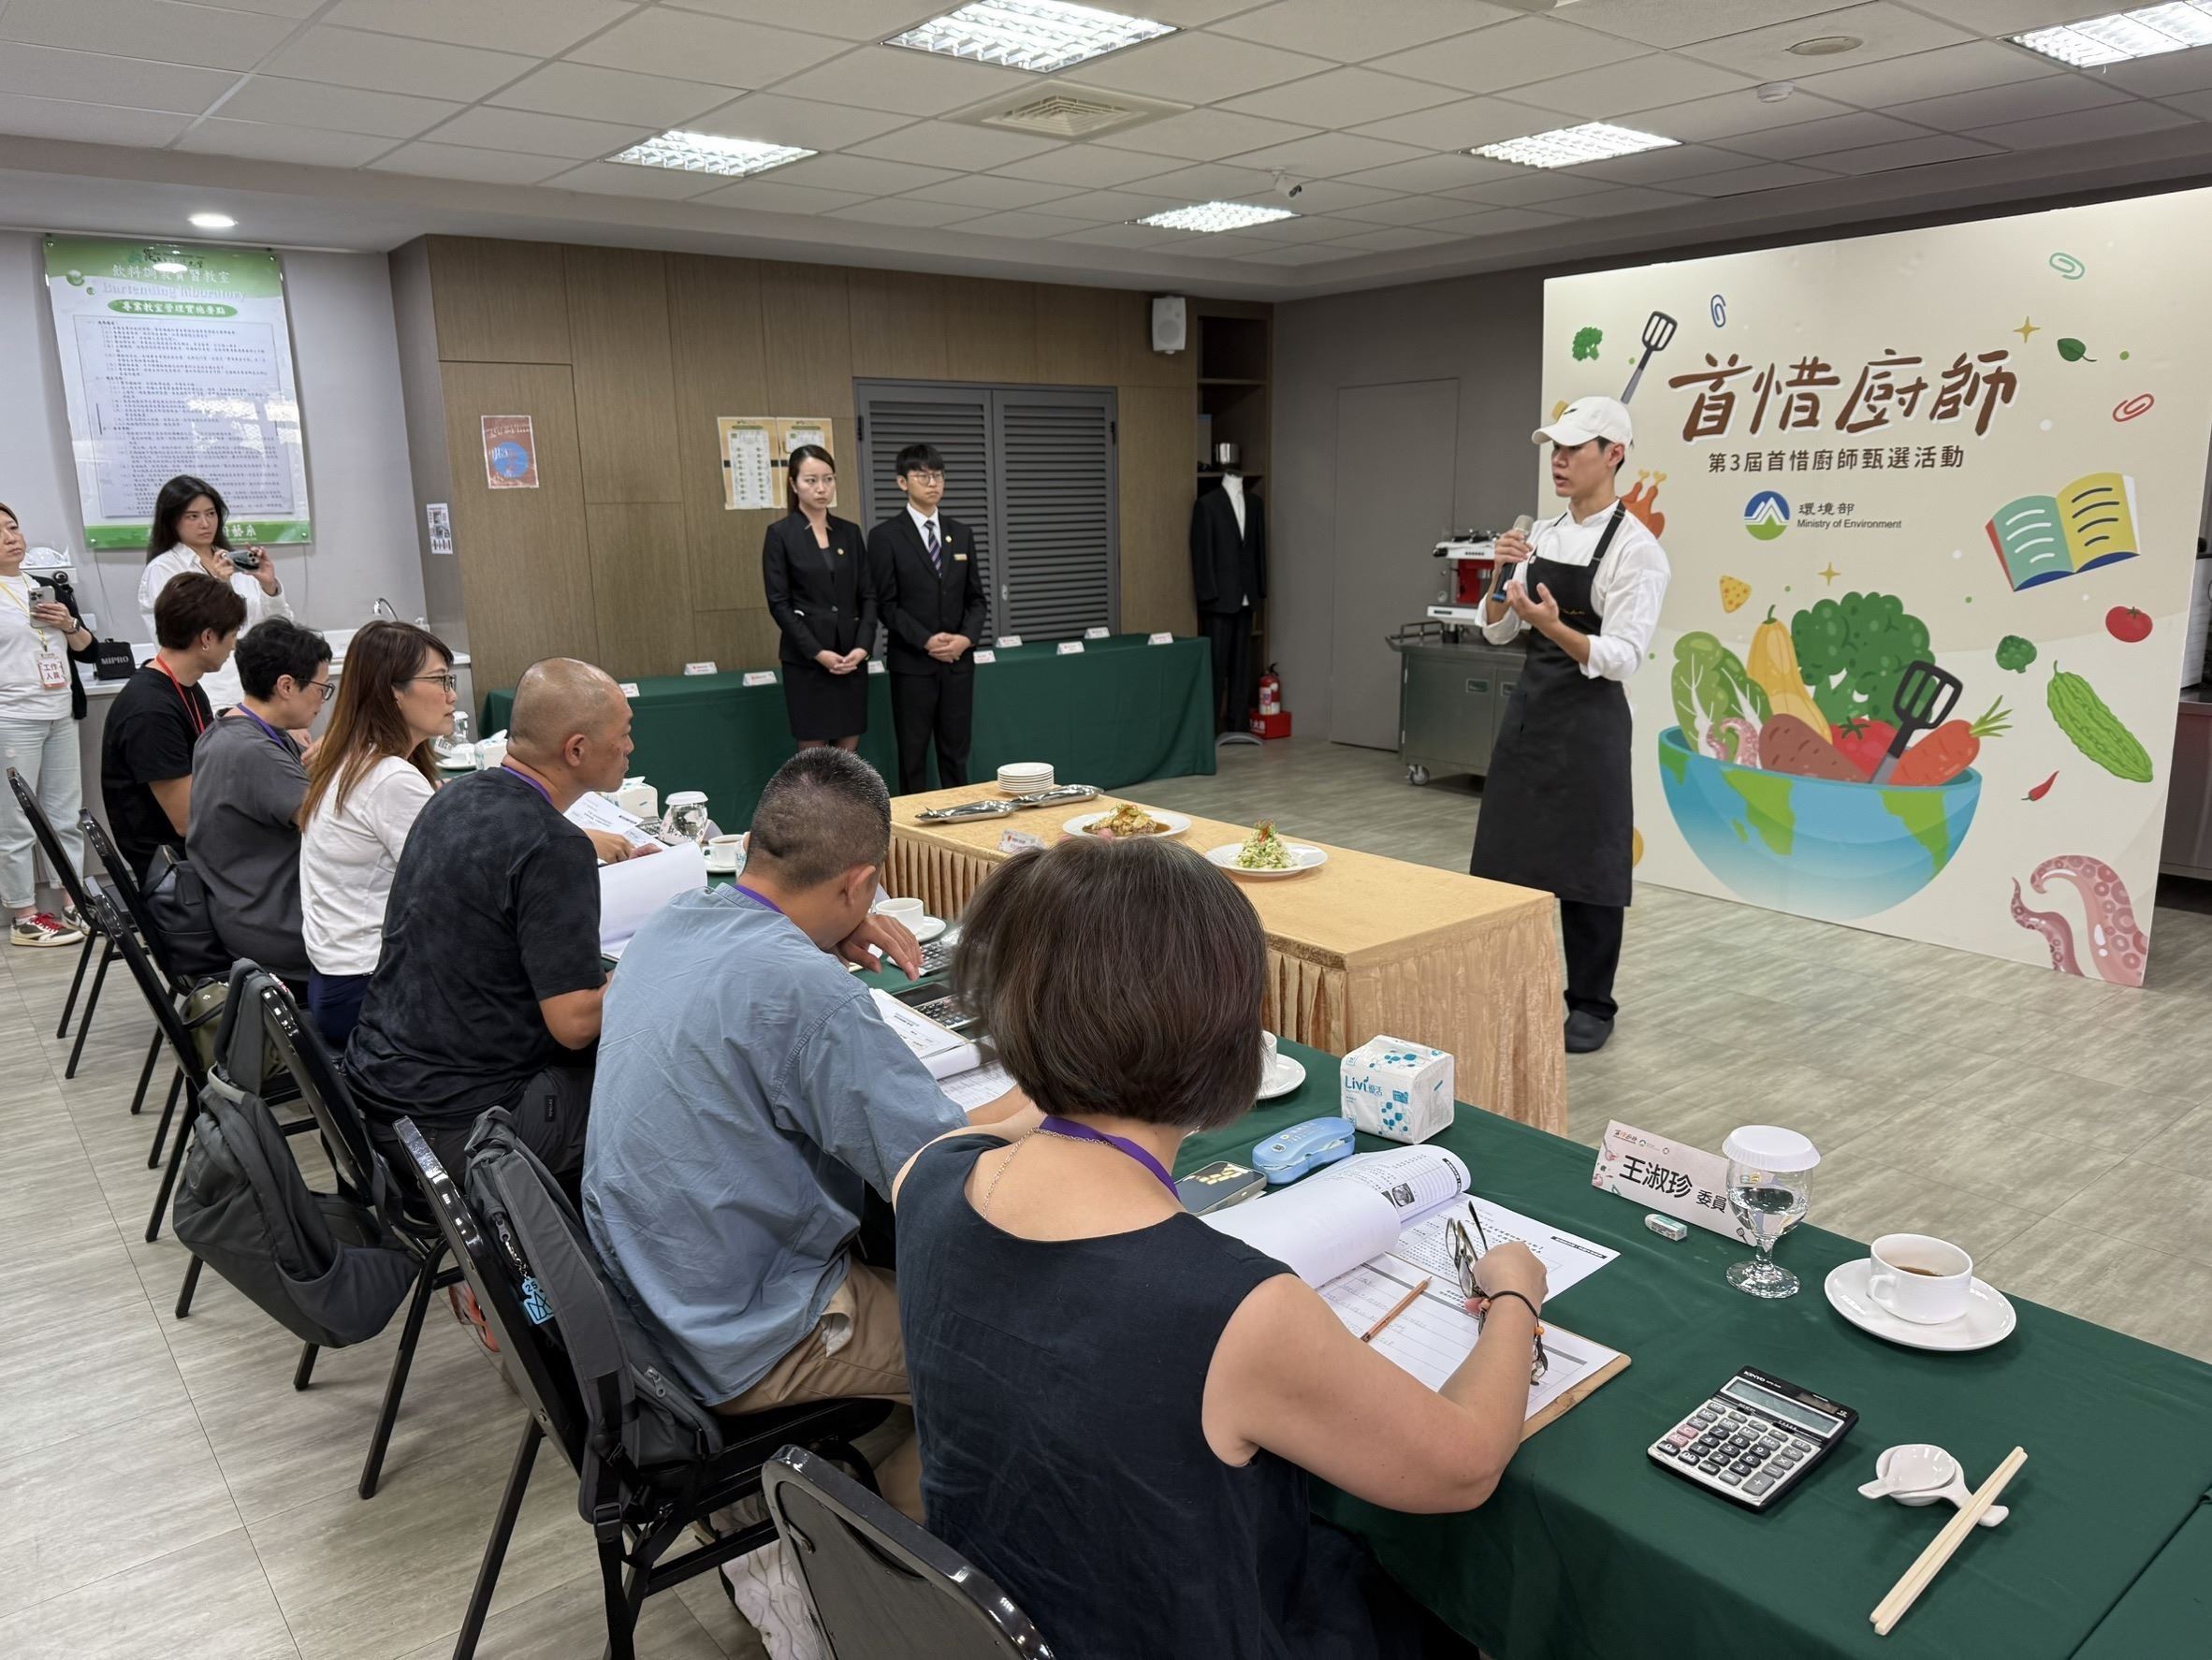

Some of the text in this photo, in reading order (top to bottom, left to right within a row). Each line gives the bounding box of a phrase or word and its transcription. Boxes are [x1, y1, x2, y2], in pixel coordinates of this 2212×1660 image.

[1668, 348, 2017, 442] 首惜廚師
[1708, 444, 1964, 473] 第3屆首惜廚師甄選活動
[1797, 502, 1855, 516] 環境部
[1797, 518, 1902, 530] Ministry of Environment
[101, 655, 129, 665] MIPRO
[1345, 1075, 1369, 1092] Livi
[1619, 1154, 1727, 1214] 王淑珍 委員
[525, 1281, 538, 1292] 25
[1743, 1370, 1766, 1382] KINYO
